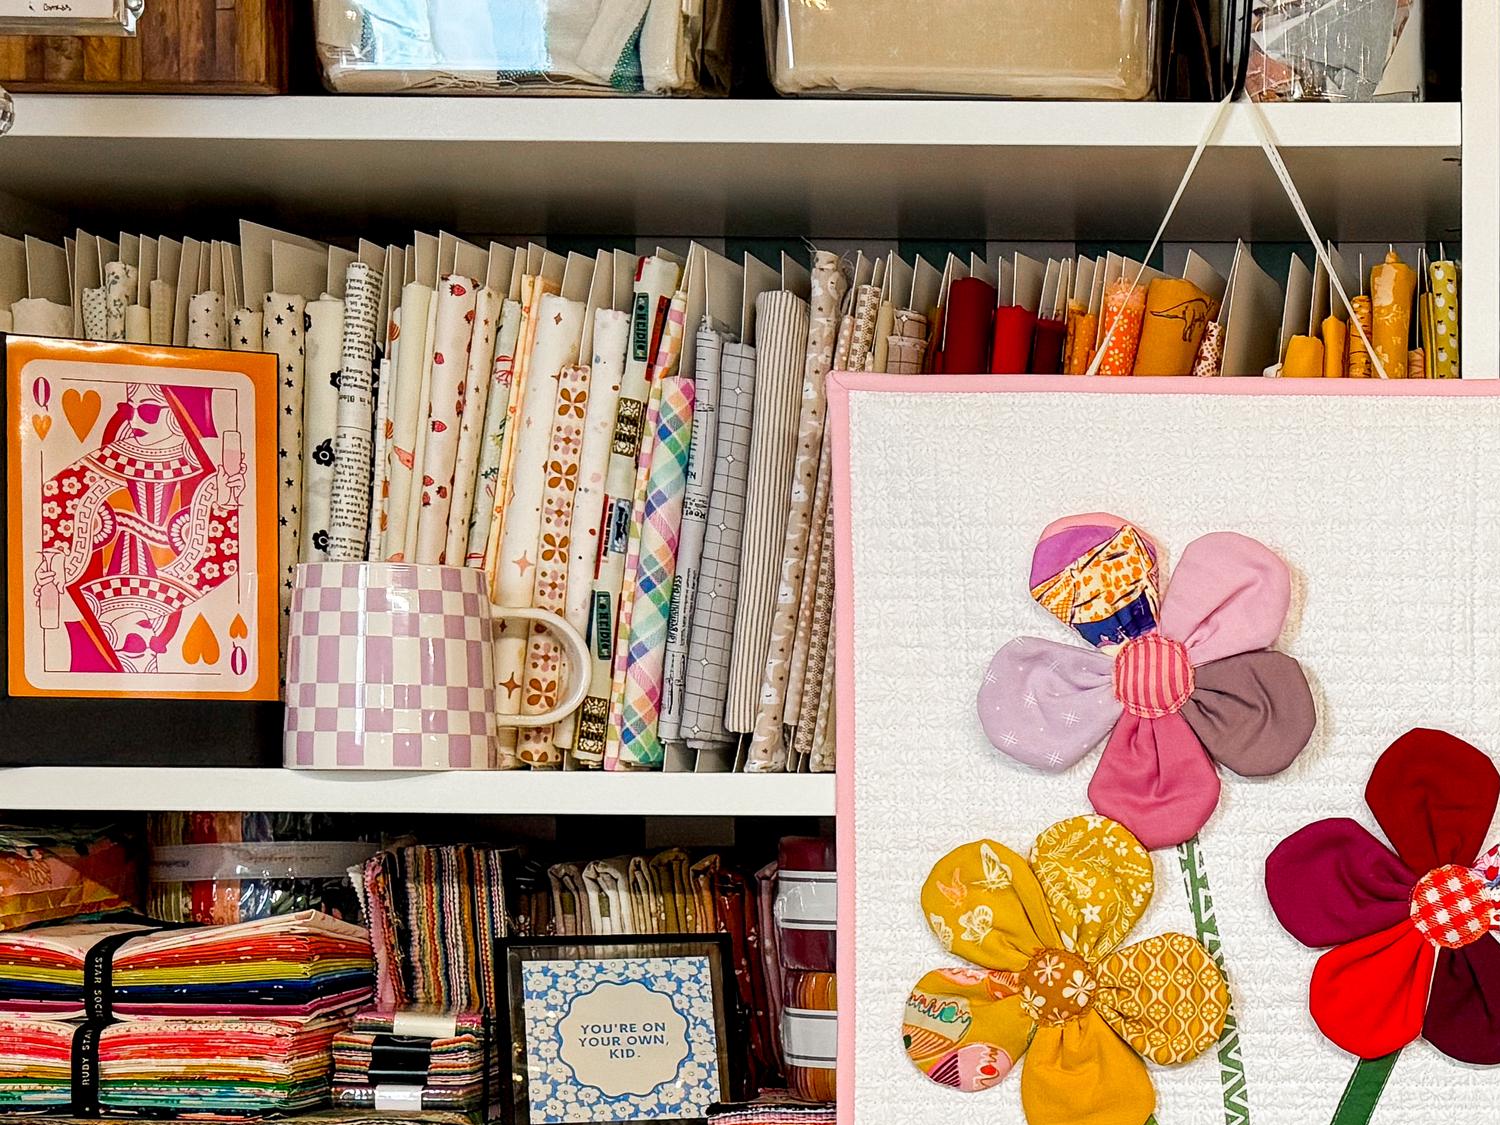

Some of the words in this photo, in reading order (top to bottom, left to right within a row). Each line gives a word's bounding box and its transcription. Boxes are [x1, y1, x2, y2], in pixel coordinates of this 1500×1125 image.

[33, 376, 51, 412] Q
[230, 641, 248, 676] Q
[94, 956, 103, 984] STAR
[580, 1023, 637, 1035] YOU'RE
[642, 1022, 666, 1032] ON
[578, 1036, 621, 1047] YOUR
[626, 1034, 669, 1046] OWN,
[609, 1048, 641, 1059] KID.
